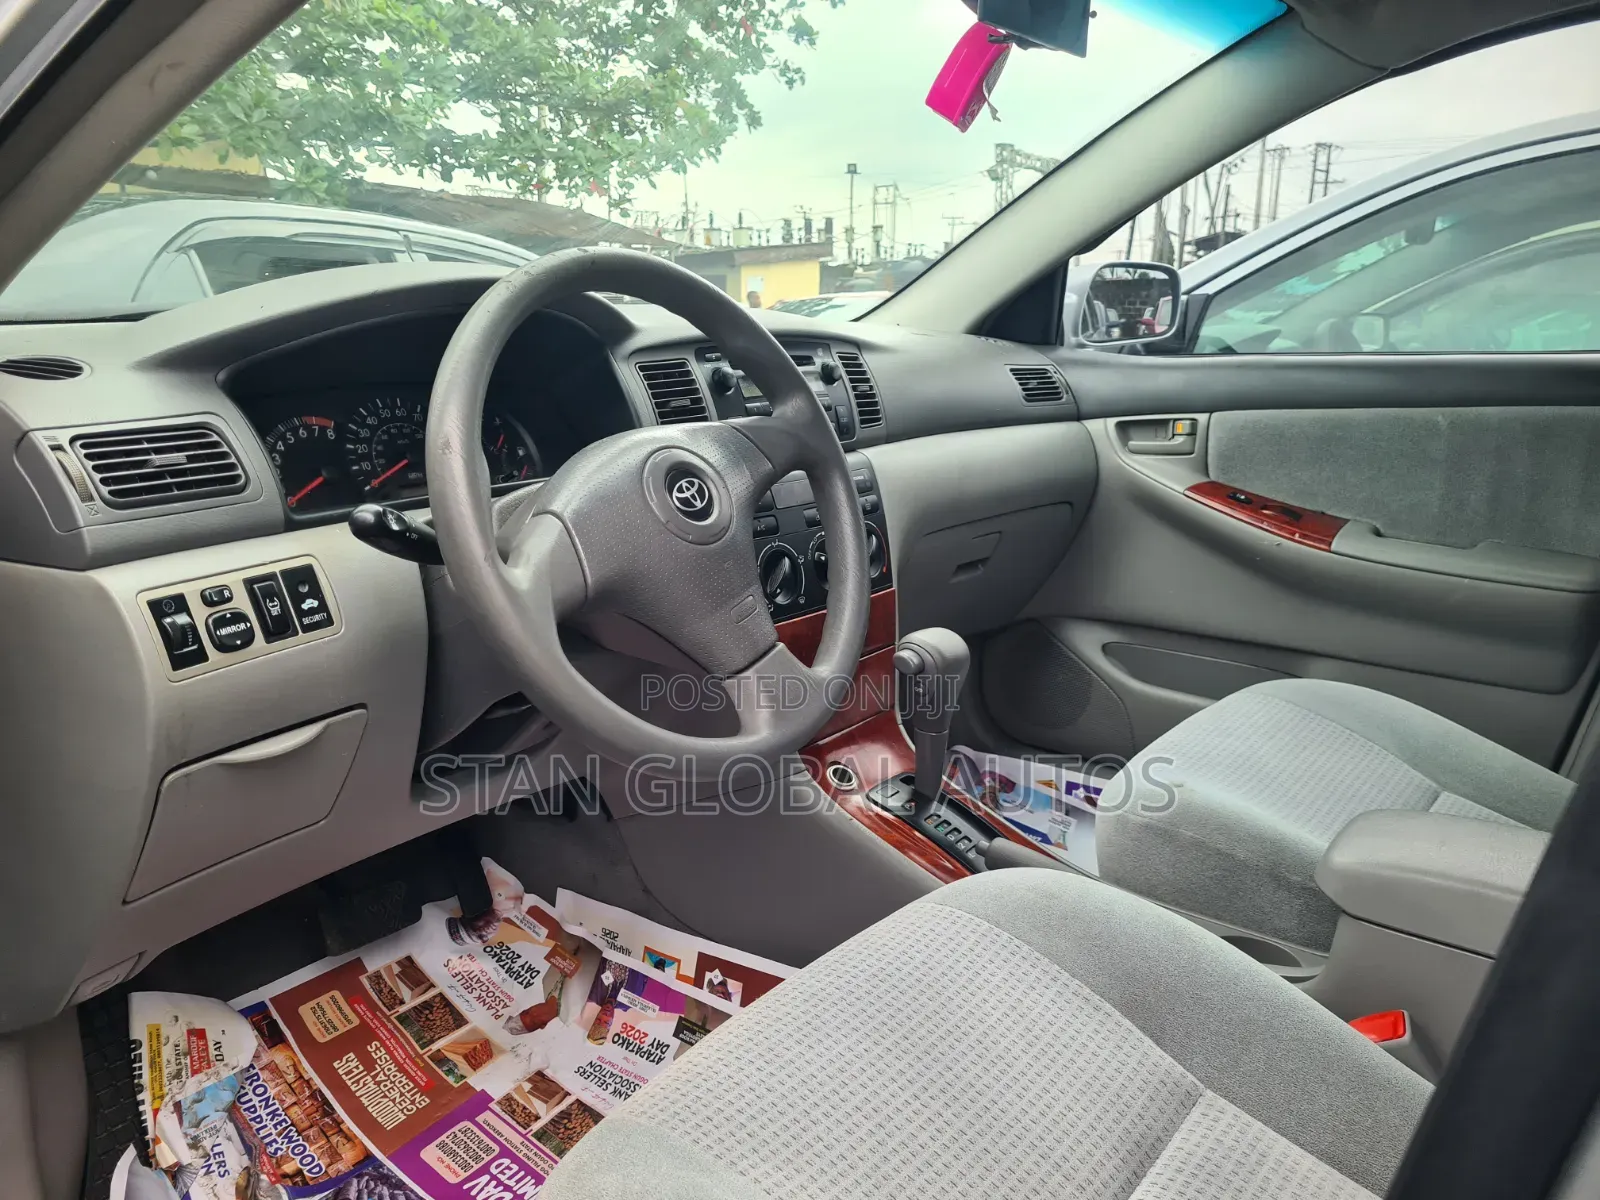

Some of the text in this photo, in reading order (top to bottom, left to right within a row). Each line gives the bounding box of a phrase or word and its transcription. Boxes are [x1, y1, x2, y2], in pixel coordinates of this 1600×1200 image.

[366, 416, 378, 424] 40
[380, 408, 423, 422] 50 60 70
[286, 432, 294, 444] 5
[299, 426, 335, 440] 6 7 8
[358, 428, 370, 438] 30
[276, 441, 284, 451] 4
[356, 444, 368, 453] 20
[272, 453, 280, 464] 3
[361, 462, 371, 470] 10
[224, 589, 230, 598] R
[302, 612, 327, 624] SECURITY
[220, 622, 247, 636] MIRROR
[600, 927, 618, 941] 2026
[493, 939, 521, 964] 2026
[481, 942, 534, 990] ATAPATAKO
[516, 958, 540, 980] DAY
[465, 951, 514, 1002] OGUN STATE CHTER
[442, 957, 503, 1021] PLANK SELLERS
[618, 1021, 670, 1055] DAY 2026
[212, 1039, 224, 1061] DAY
[610, 1031, 665, 1067] ATAPATAKO
[366, 1039, 430, 1108] ENTERPRISES
[584, 1058, 642, 1093] SSOCIATION
[596, 1054, 649, 1084] OGUN STATE CHAPTER
[331, 1050, 407, 1130] WOODMASTERS
[366, 1063, 417, 1116] GENERAL
[573, 1064, 632, 1103] ANK SELLERS
[280, 1126, 324, 1177] WOOD
[445, 1130, 484, 1165] 08028620743
[503, 1135, 524, 1153] STATION
[519, 1139, 535, 1152] STATE
[209, 1142, 230, 1179] LERS
[435, 1139, 474, 1172] 08033680188
[521, 1151, 541, 1168] FILLING
[532, 1150, 549, 1164] OGUN
[444, 1162, 461, 1178] PHONE
